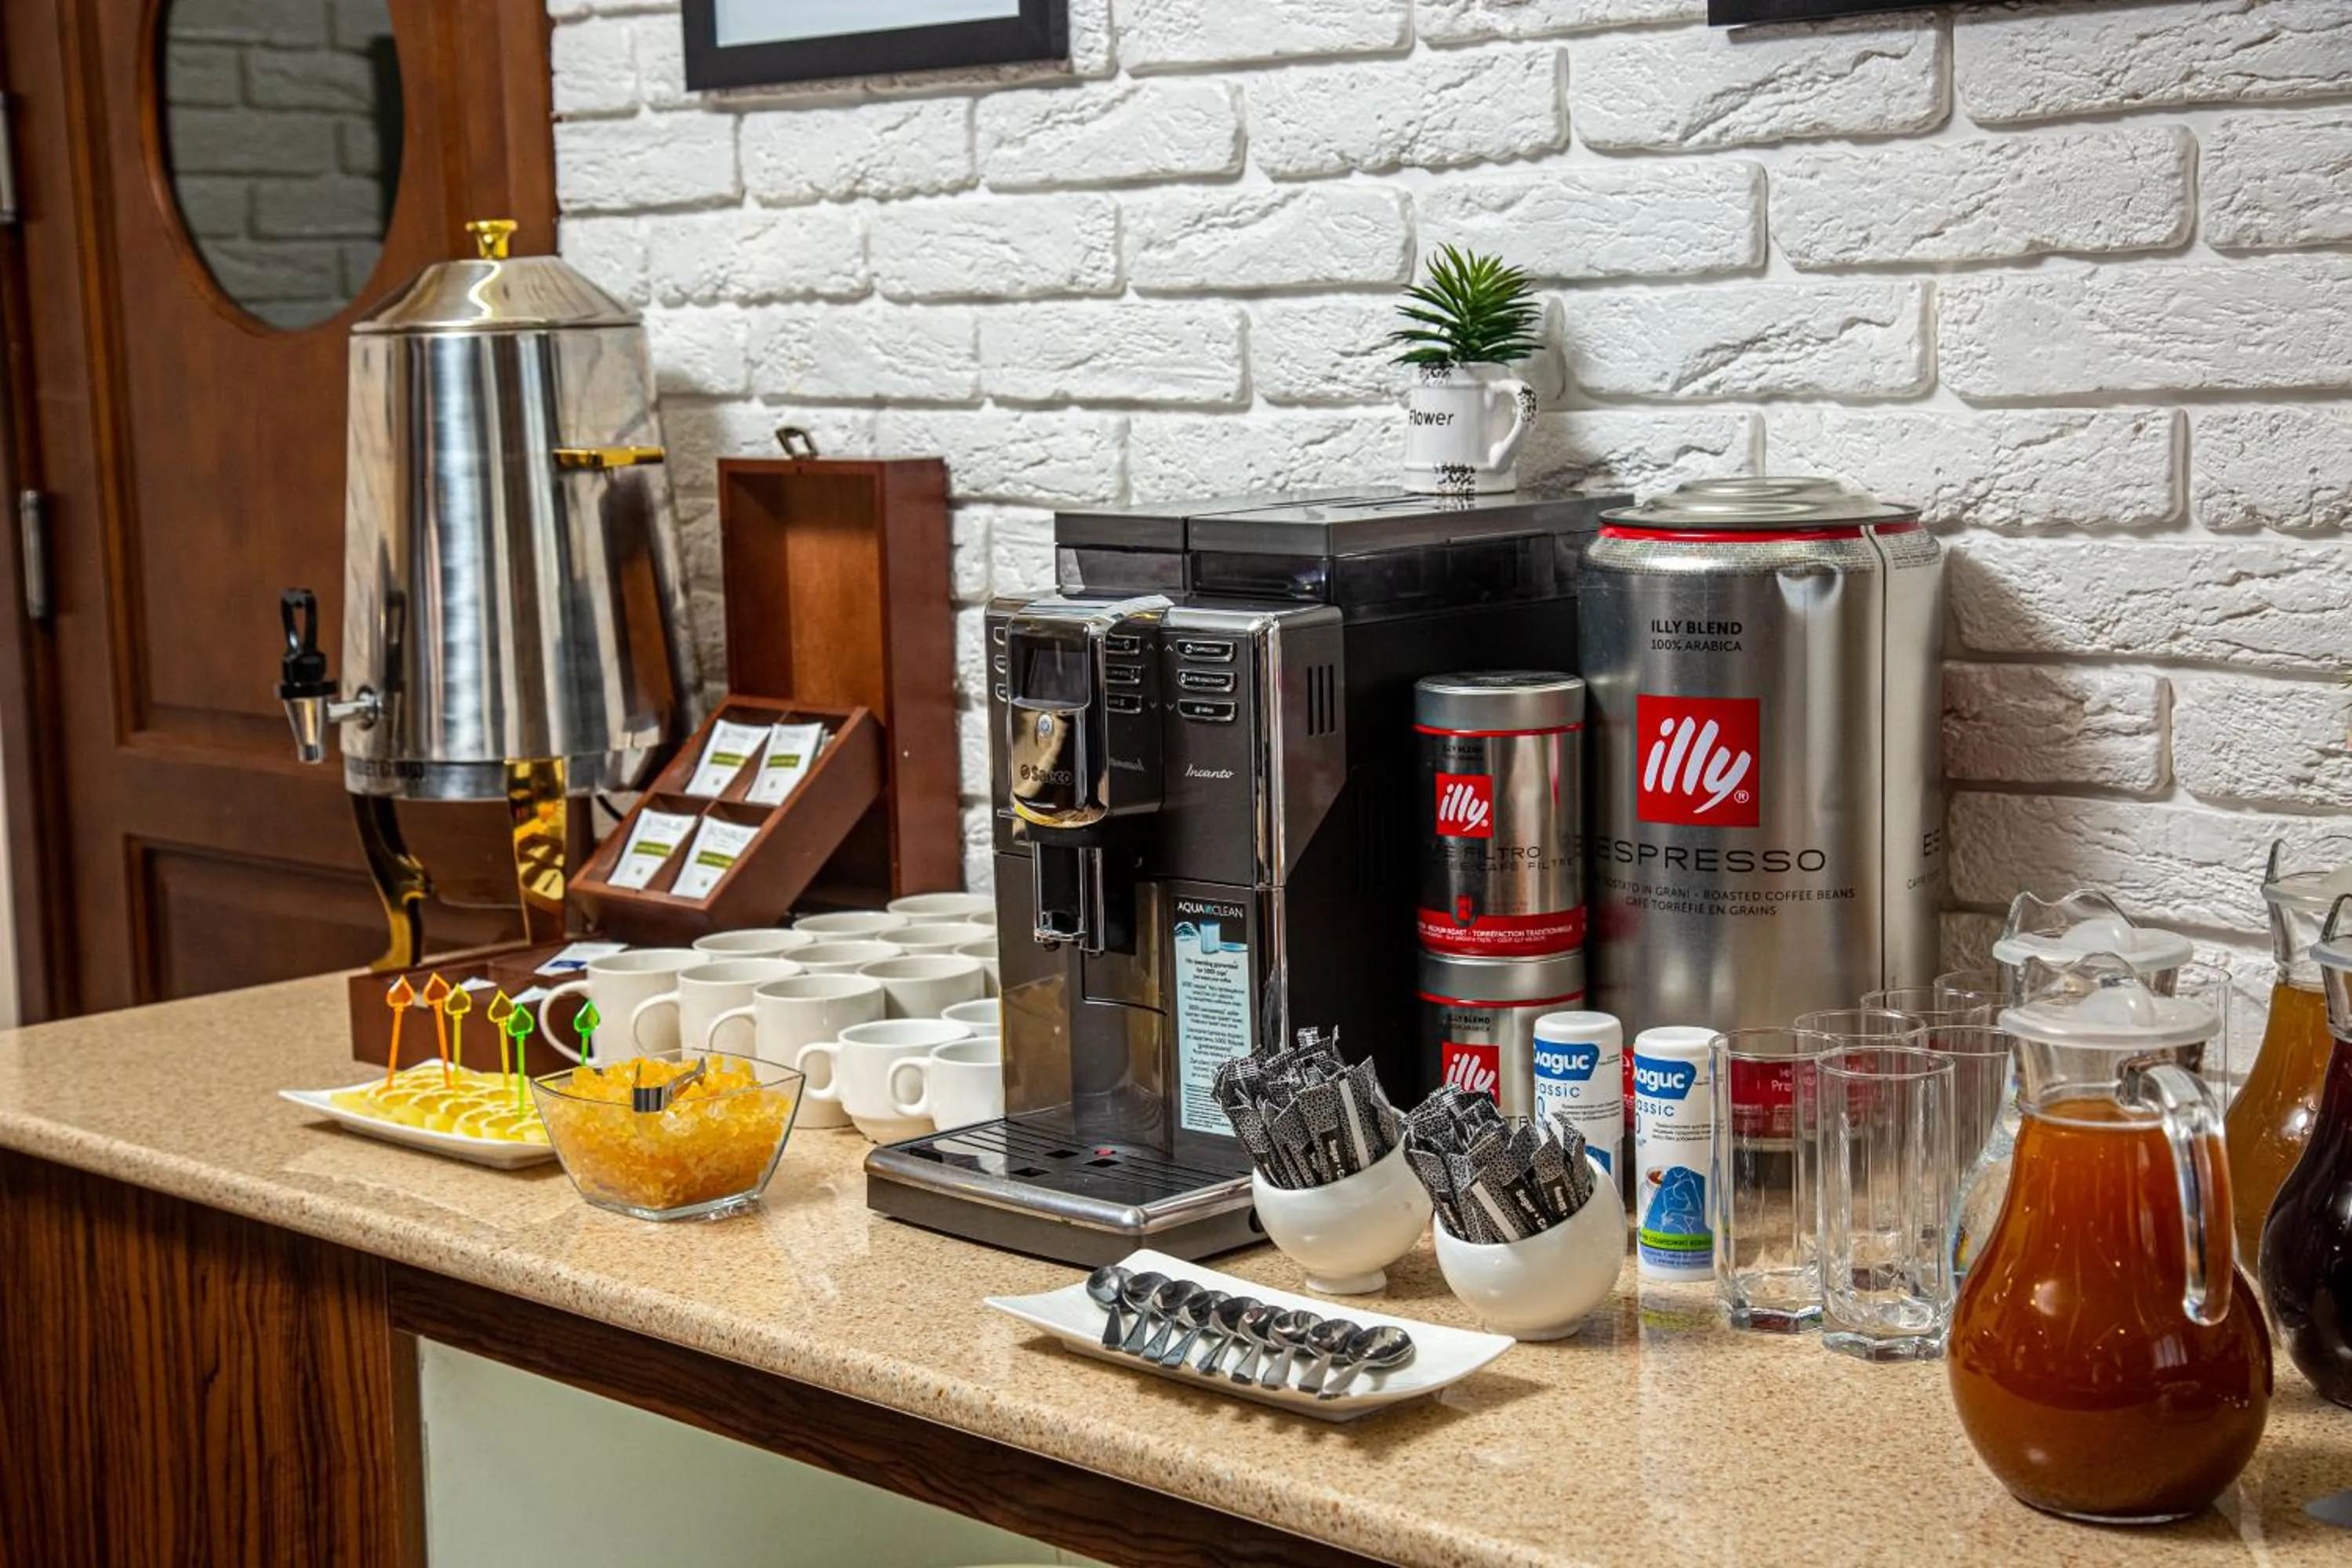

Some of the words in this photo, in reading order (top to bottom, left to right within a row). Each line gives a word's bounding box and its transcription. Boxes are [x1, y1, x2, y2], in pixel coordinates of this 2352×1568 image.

[1409, 409, 1454, 426] Flower
[1651, 619, 1682, 633] ILLY
[1686, 621, 1743, 635] BLEND
[1651, 639, 1682, 651] 100%
[1685, 640, 1742, 652] ARABICA
[1185, 764, 1235, 779] Incanto
[1644, 716, 1752, 814] illy
[1439, 782, 1489, 832] illy
[1596, 836, 1826, 873] ESPRESSO
[1703, 889, 1762, 902] ROASTED
[1765, 889, 1813, 902] COFFEE
[1817, 887, 1856, 900] BEANS
[1708, 905, 1726, 915] EN
[1729, 905, 1777, 916] GRAINS
